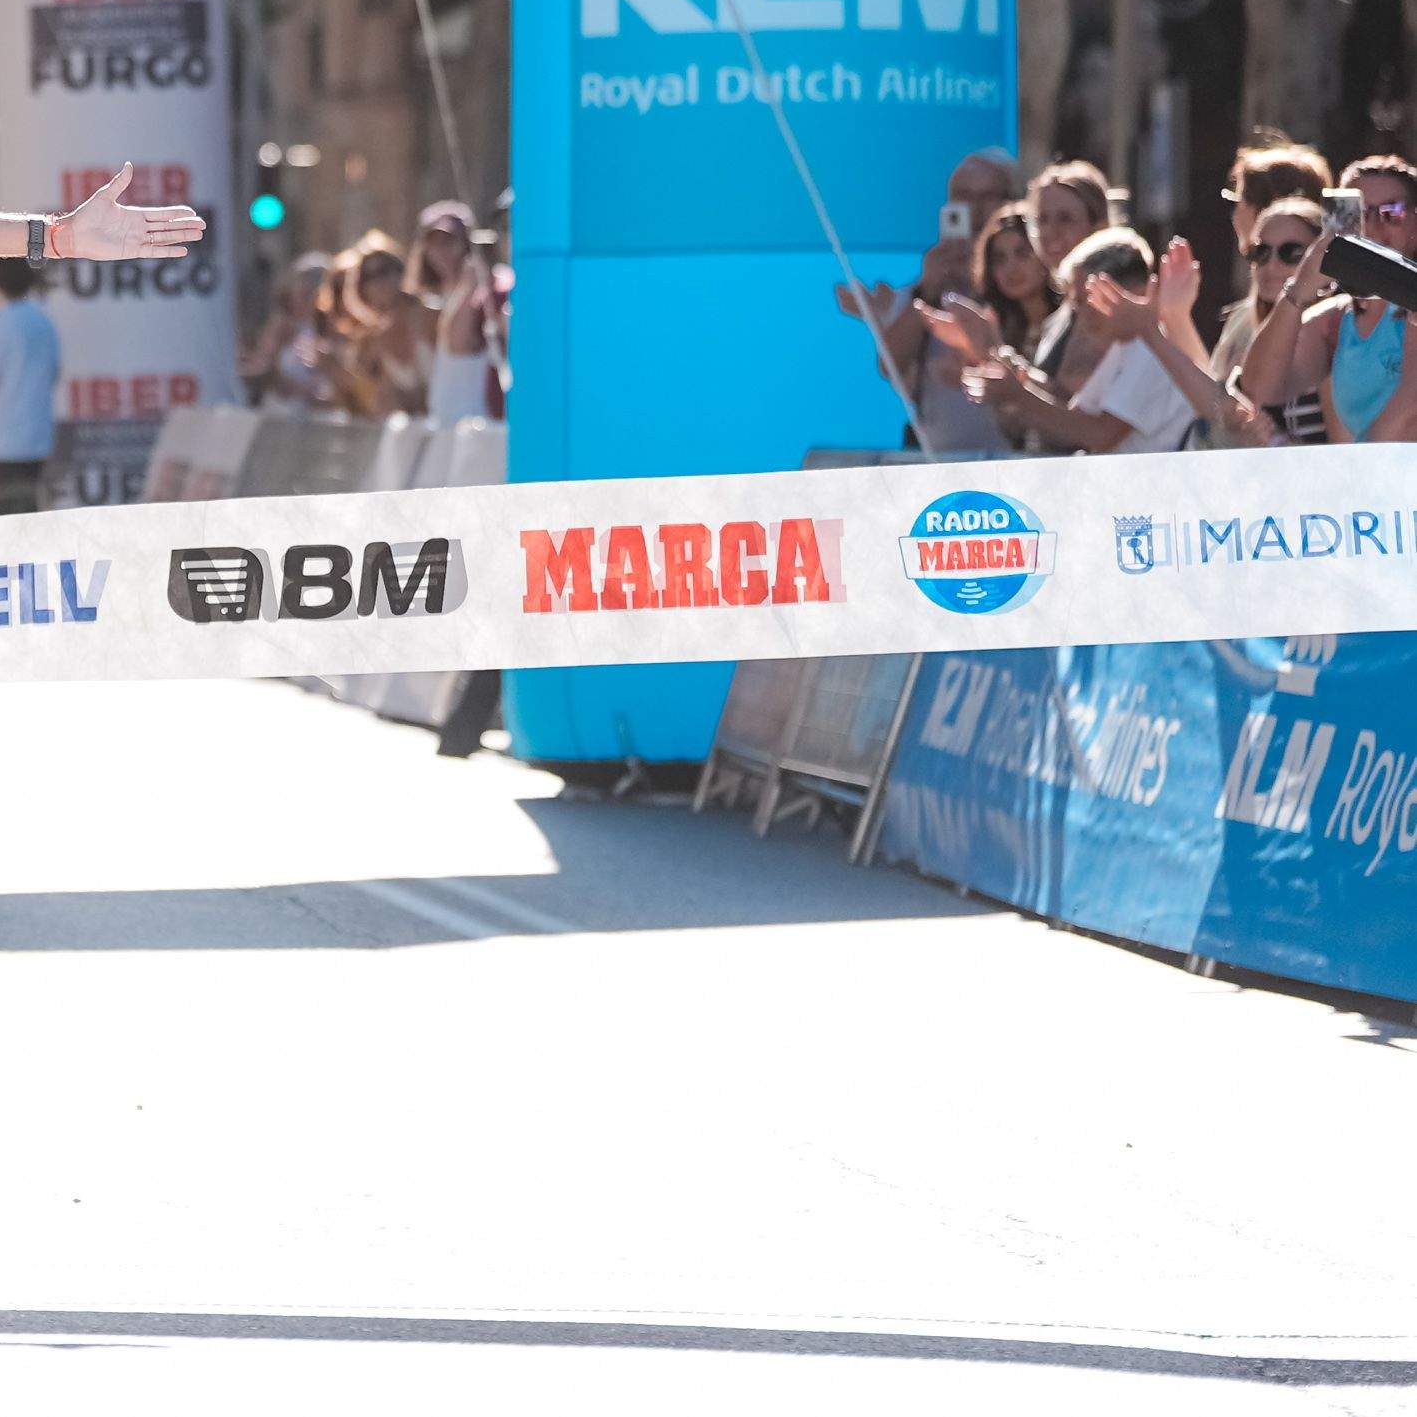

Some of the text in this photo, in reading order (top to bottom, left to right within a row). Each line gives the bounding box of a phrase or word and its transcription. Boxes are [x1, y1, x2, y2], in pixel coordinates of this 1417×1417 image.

[30, 53, 209, 94] FURGO
[580, 63, 698, 116] Royal
[716, 62, 862, 105] Dutch
[926, 508, 1010, 533] RADIO
[1199, 510, 1417, 564] MADRI
[278, 537, 450, 619] BM
[520, 519, 830, 614] MARCA
[917, 537, 1025, 572] MARCA
[1214, 712, 1336, 833] KLM
